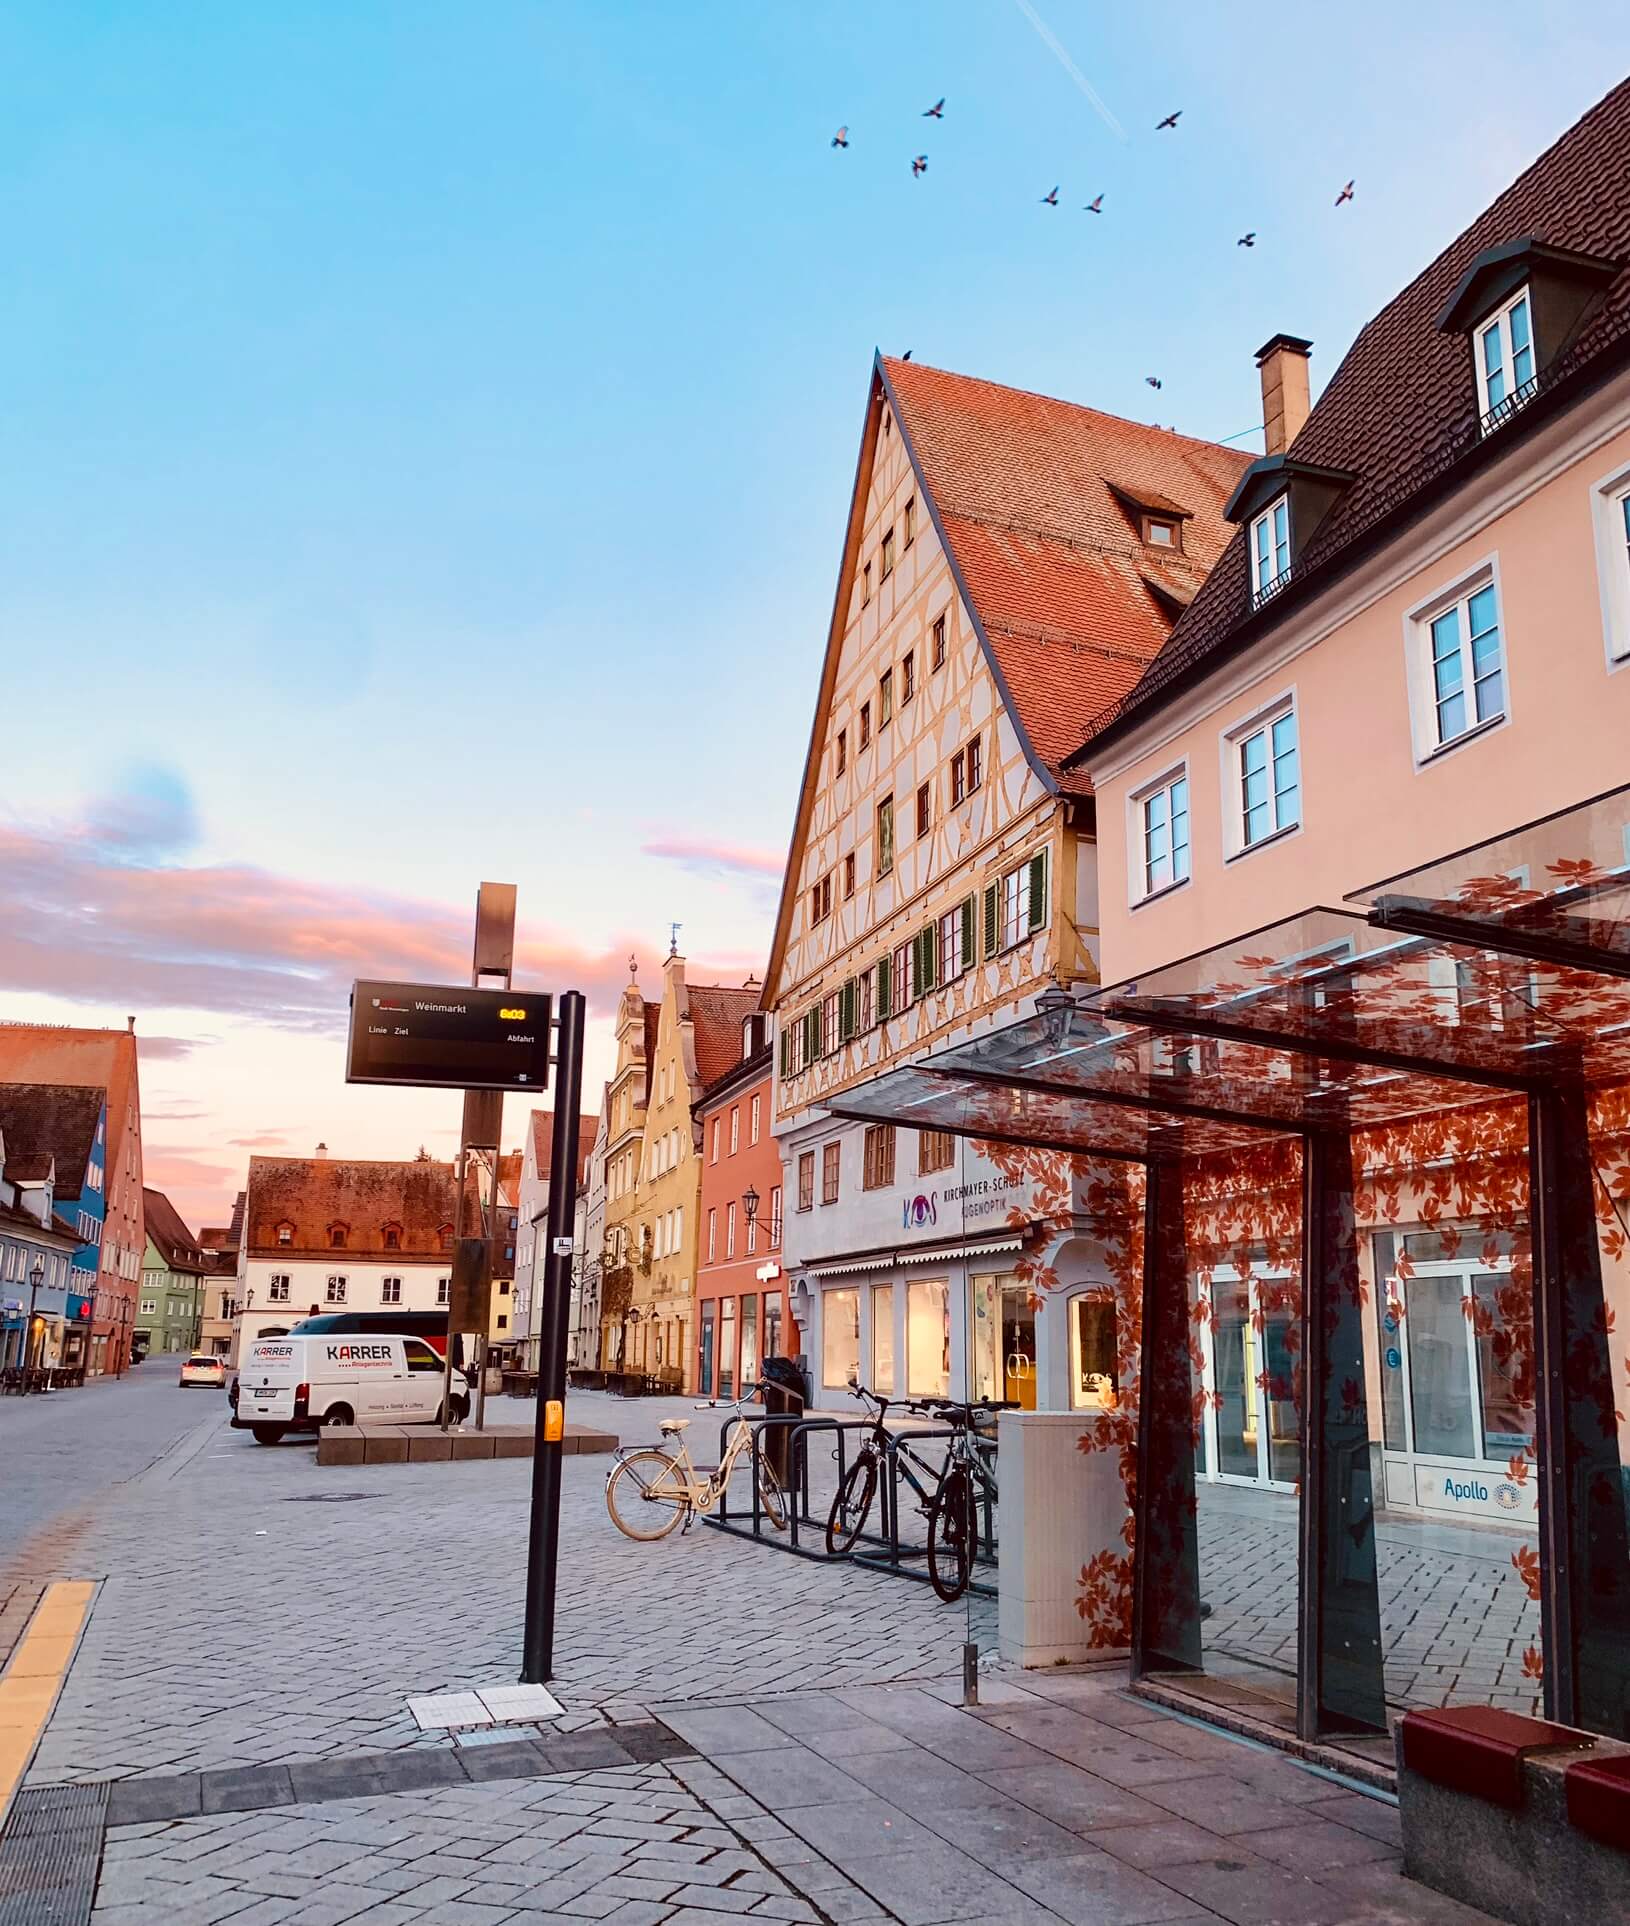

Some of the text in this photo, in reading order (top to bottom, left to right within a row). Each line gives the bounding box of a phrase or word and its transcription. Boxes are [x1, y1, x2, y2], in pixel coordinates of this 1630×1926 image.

[415, 1001, 467, 1014] Weinmarkt
[368, 1025, 409, 1036] Linie Ziel
[507, 1034, 535, 1043] Abfahrt
[253, 1347, 293, 1357] KARRER
[327, 1345, 392, 1360] KARRER
[1445, 1478, 1488, 1501] Apollo
